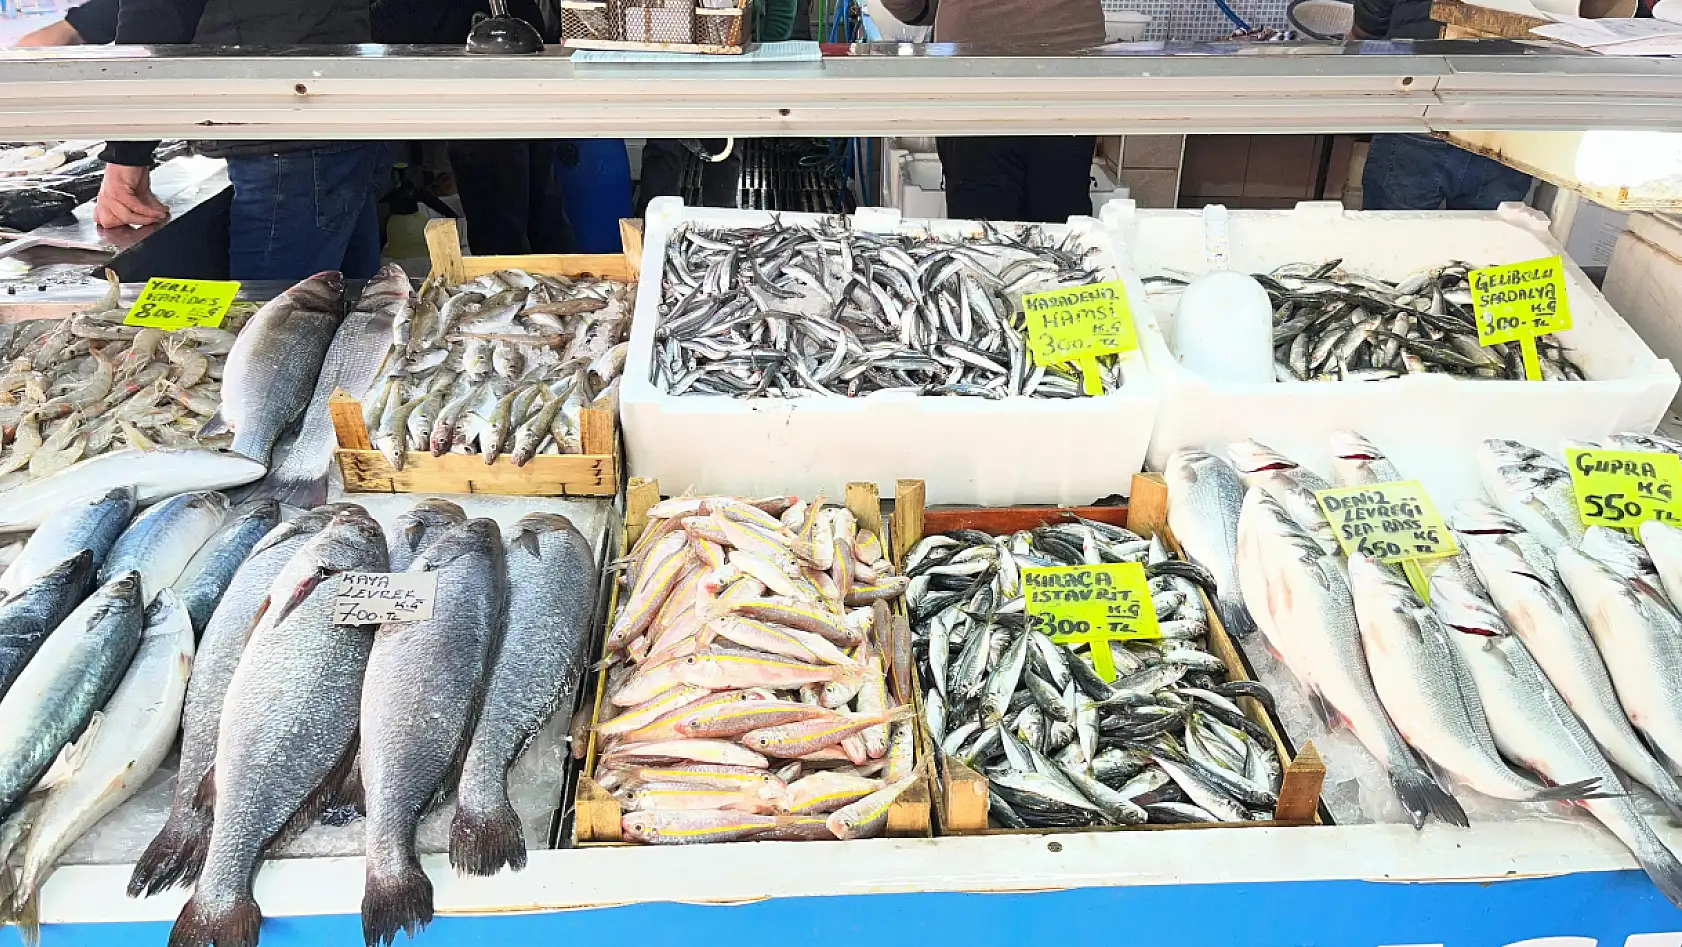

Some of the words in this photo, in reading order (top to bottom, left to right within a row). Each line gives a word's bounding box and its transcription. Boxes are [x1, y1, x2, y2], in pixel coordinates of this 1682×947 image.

[1584, 494, 1642, 520] 550
[1653, 509, 1681, 522] TL
[343, 574, 389, 588] KAYA
[336, 586, 416, 599] LEVREK
